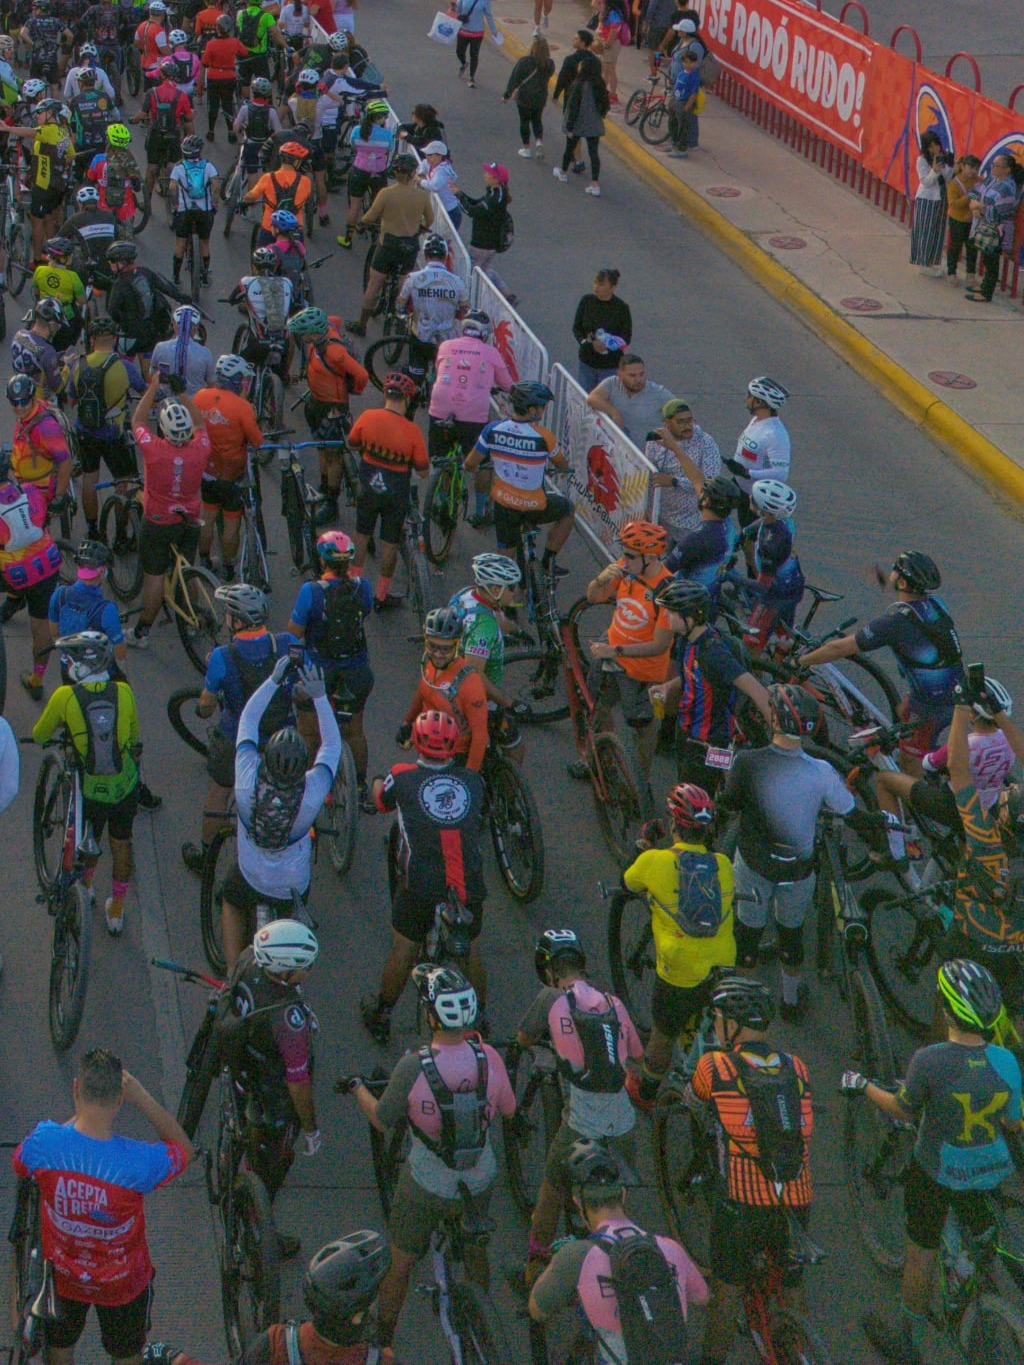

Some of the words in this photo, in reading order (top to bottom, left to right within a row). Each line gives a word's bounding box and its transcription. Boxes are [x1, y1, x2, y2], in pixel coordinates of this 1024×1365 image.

[731, 2, 789, 81] RODÓ
[790, 35, 866, 128] RUDO!
[418, 288, 456, 299] MEXICO
[54, 1176, 109, 1207] ACEPTA
